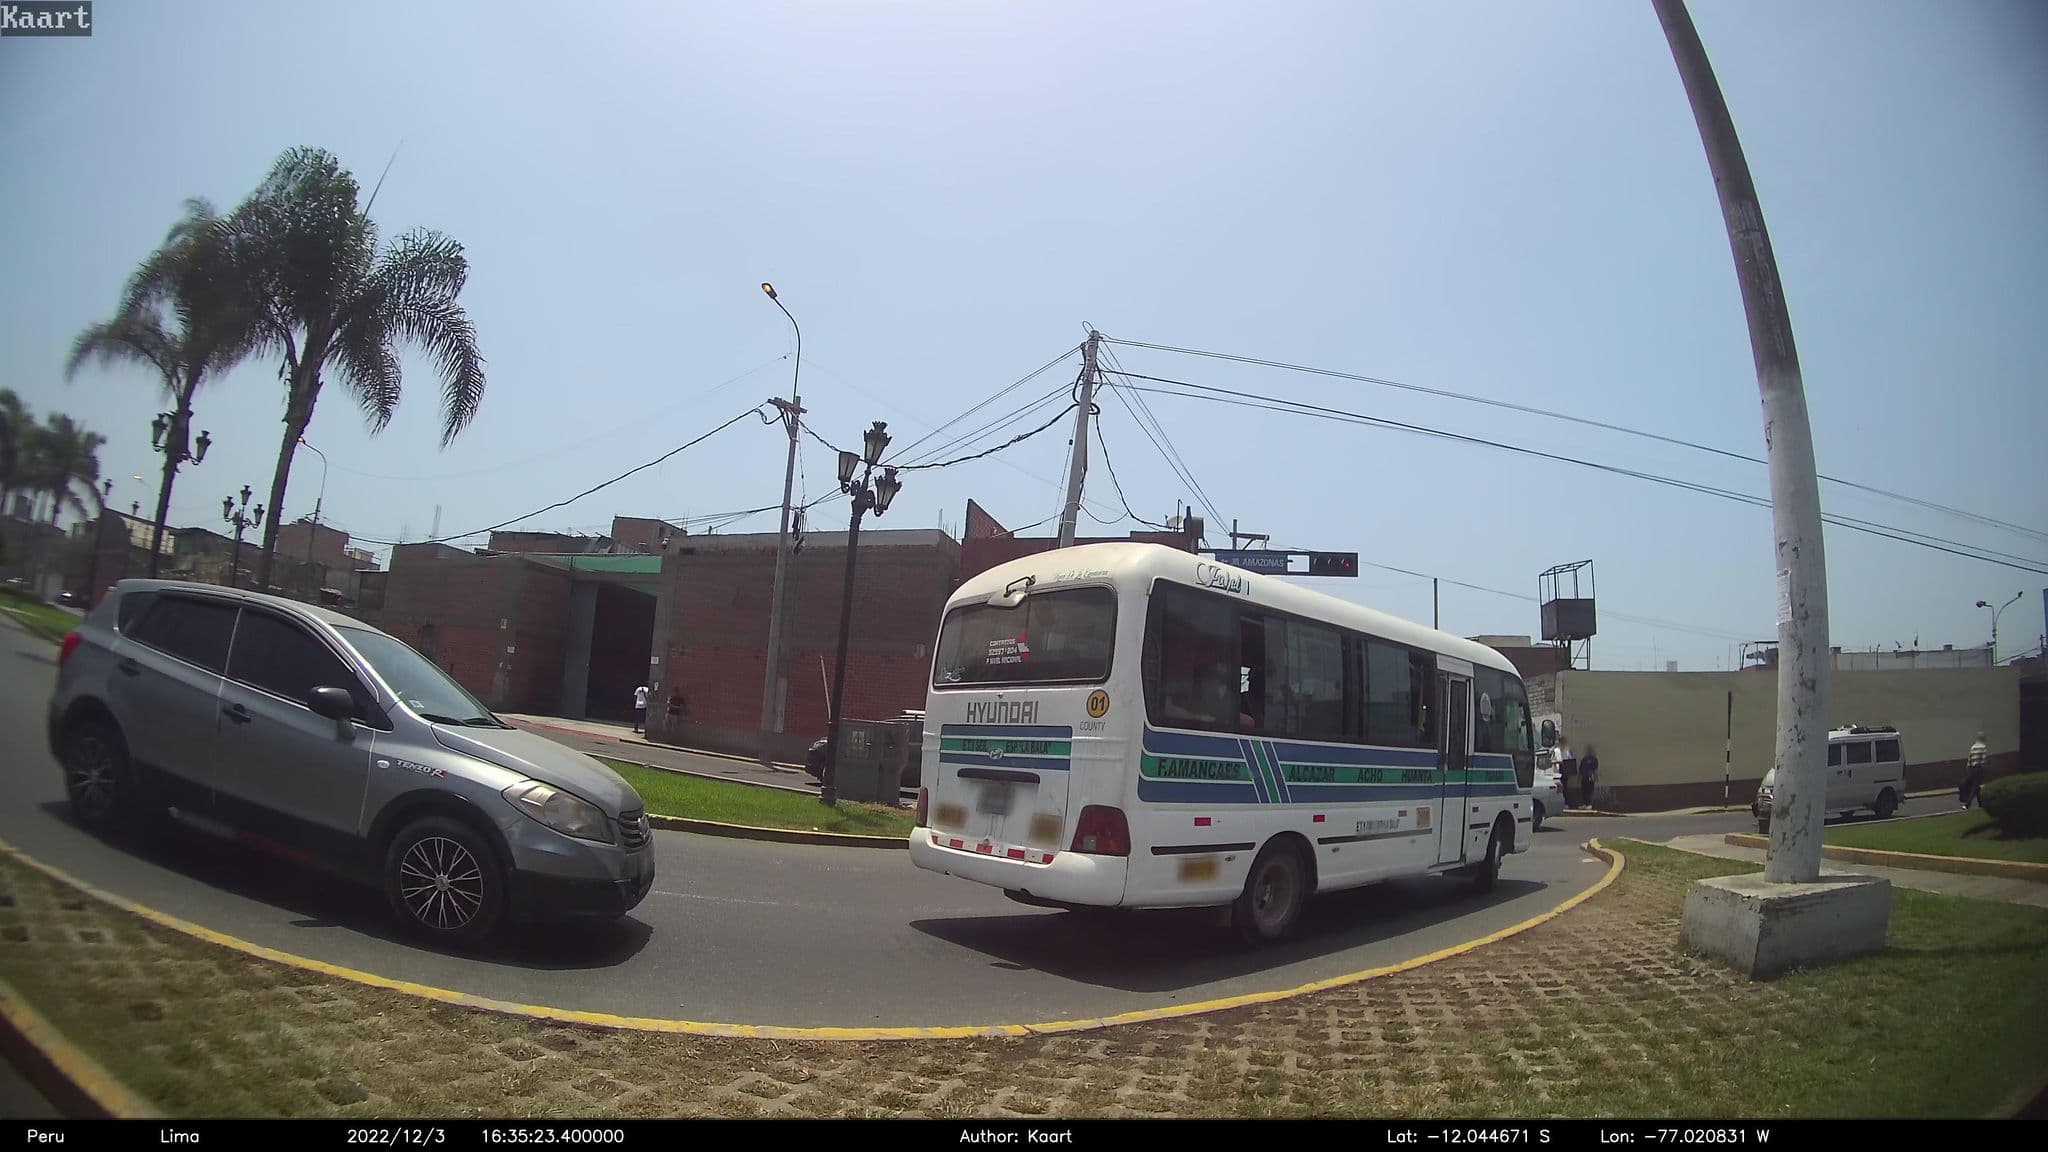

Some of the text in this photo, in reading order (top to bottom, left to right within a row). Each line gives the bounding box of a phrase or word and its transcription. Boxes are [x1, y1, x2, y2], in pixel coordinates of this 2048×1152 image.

[1242, 558, 1284, 568] AMAZONAS
[1091, 696, 1105, 711] 01
[966, 701, 1039, 724] HYUNDAI
[1079, 721, 1106, 732] COUNTY
[396, 759, 431, 773] TENZO
[1357, 768, 1383, 783] ACHO
